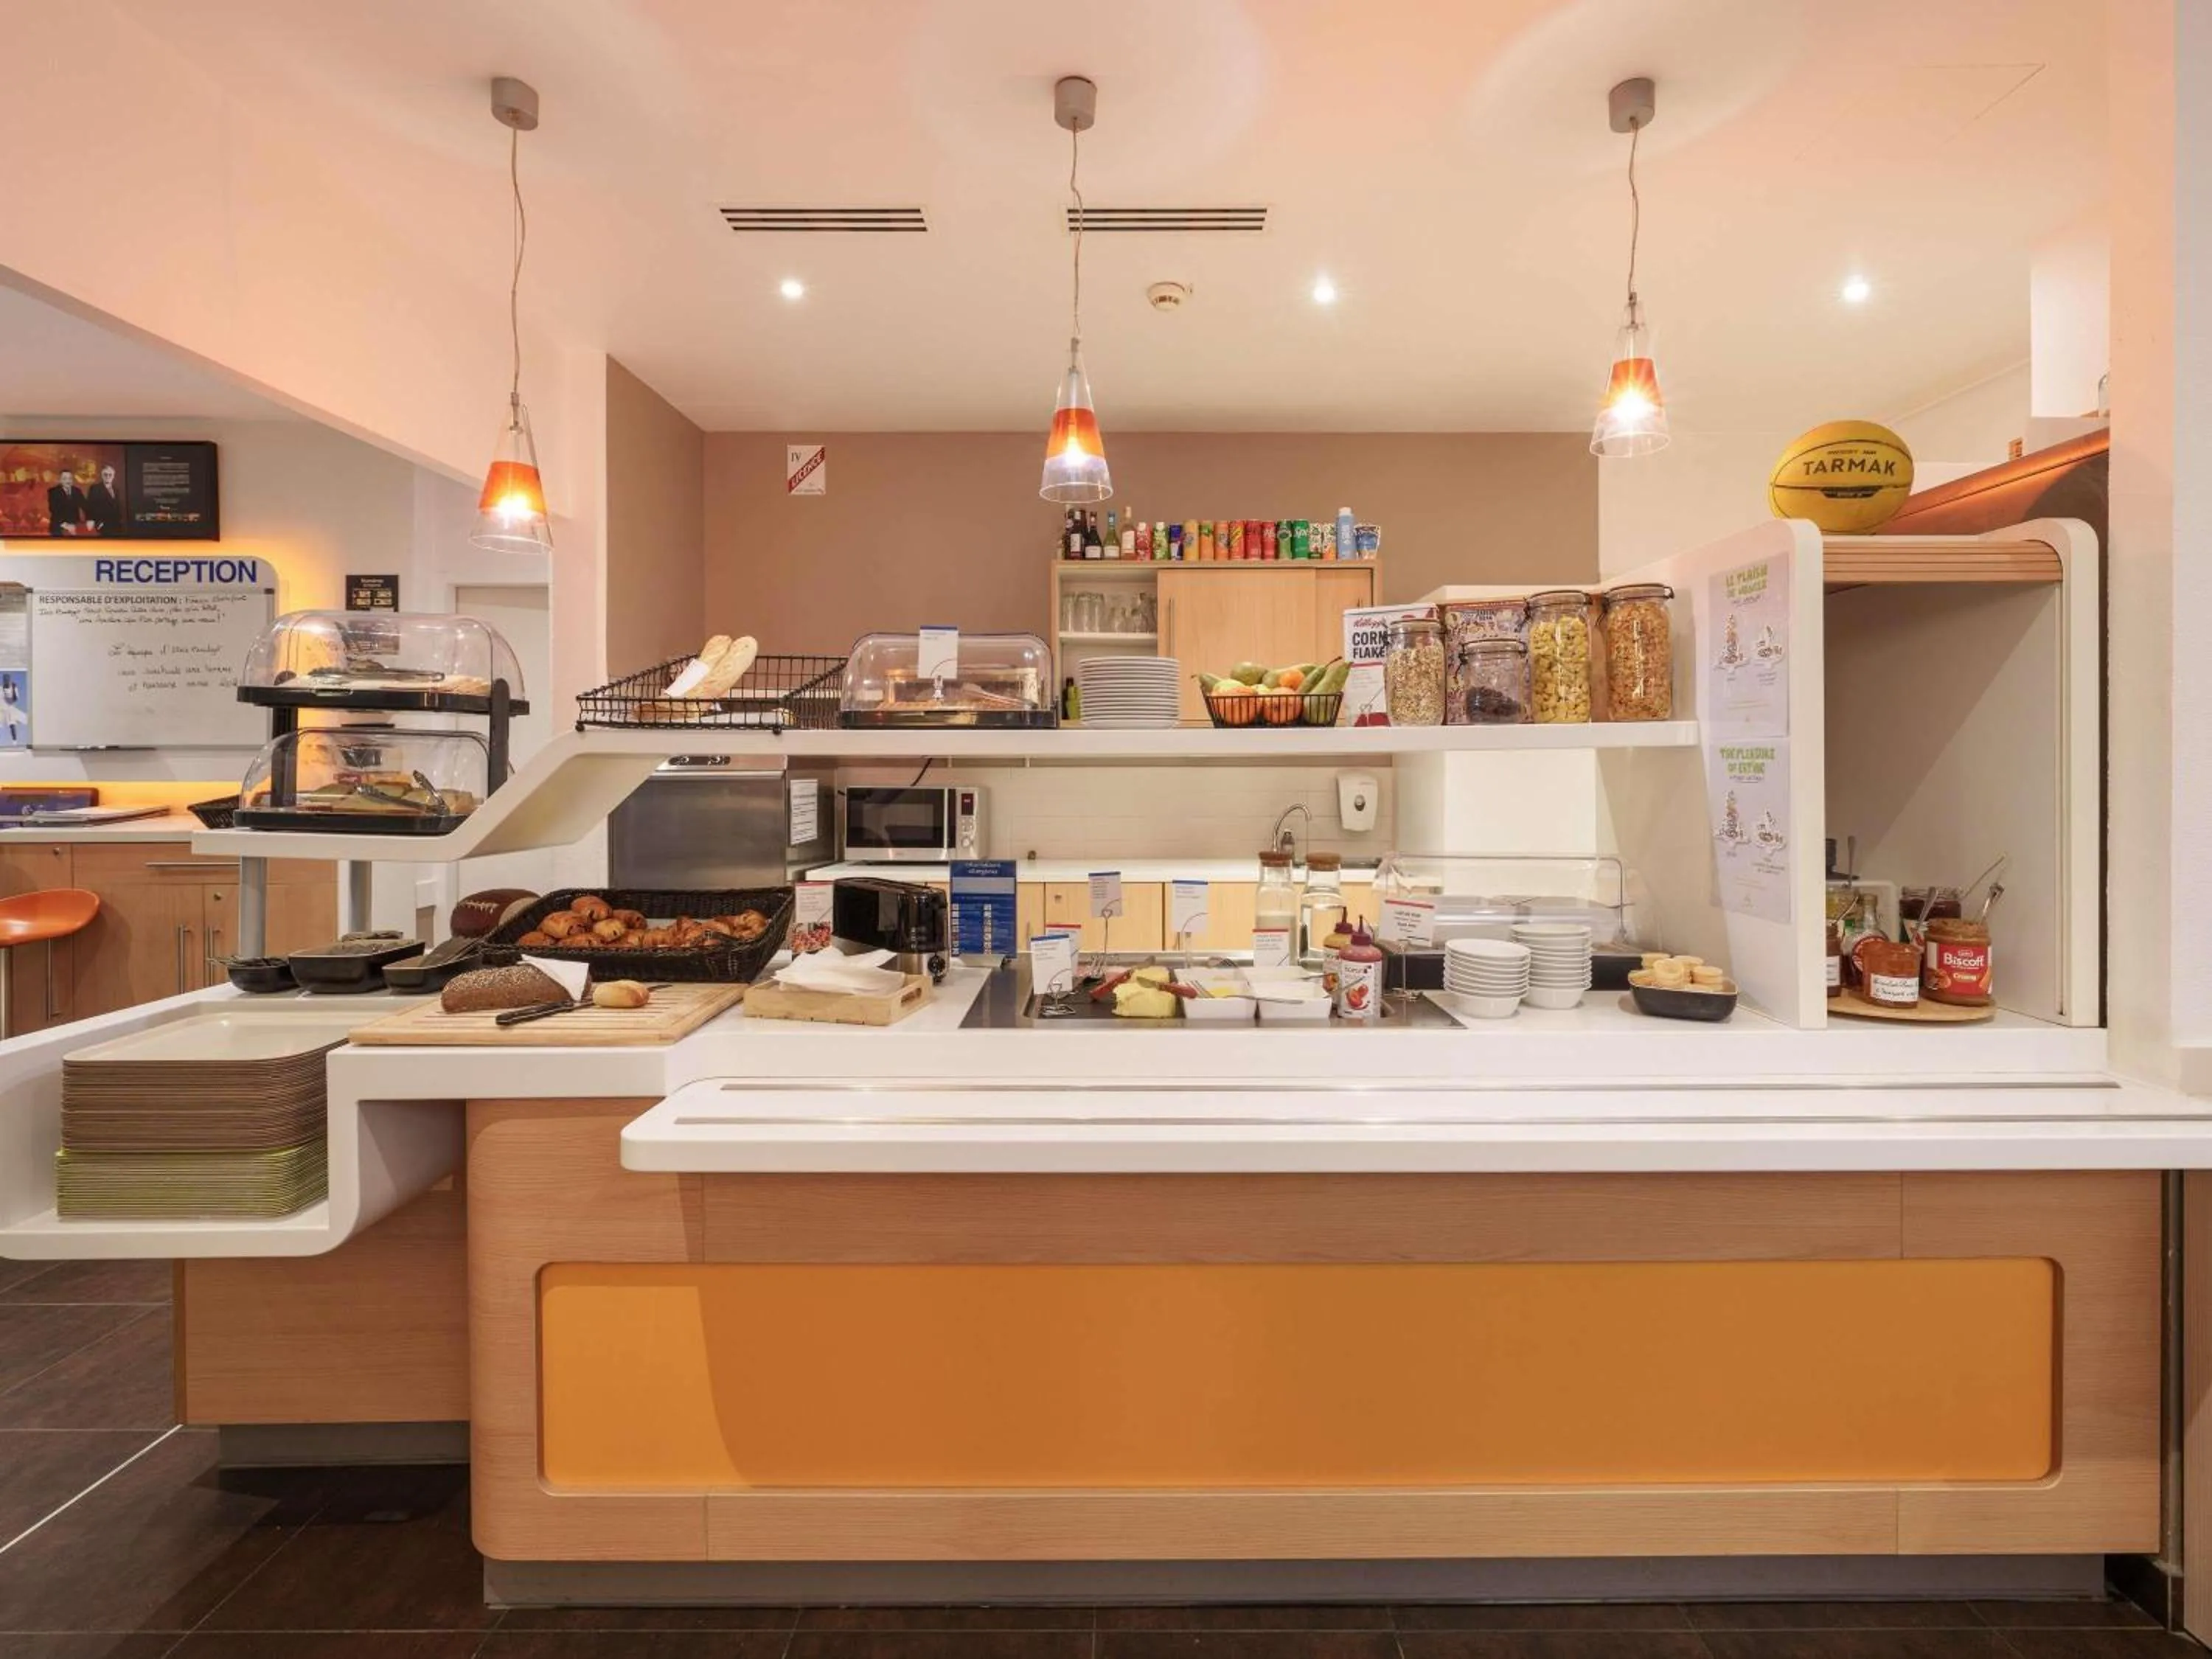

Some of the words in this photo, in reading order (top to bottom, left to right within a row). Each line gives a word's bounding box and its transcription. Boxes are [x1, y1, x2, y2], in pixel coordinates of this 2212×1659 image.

[1803, 458, 1896, 476] TARMAK
[95, 560, 257, 583] RECEPTION
[39, 595, 103, 605] RESPONSABLE
[1354, 617, 1382, 629] Kellogg
[1352, 630, 1388, 646] CORN
[1353, 646, 1385, 659] FLAKE
[1943, 952, 1985, 967] Biscoff
